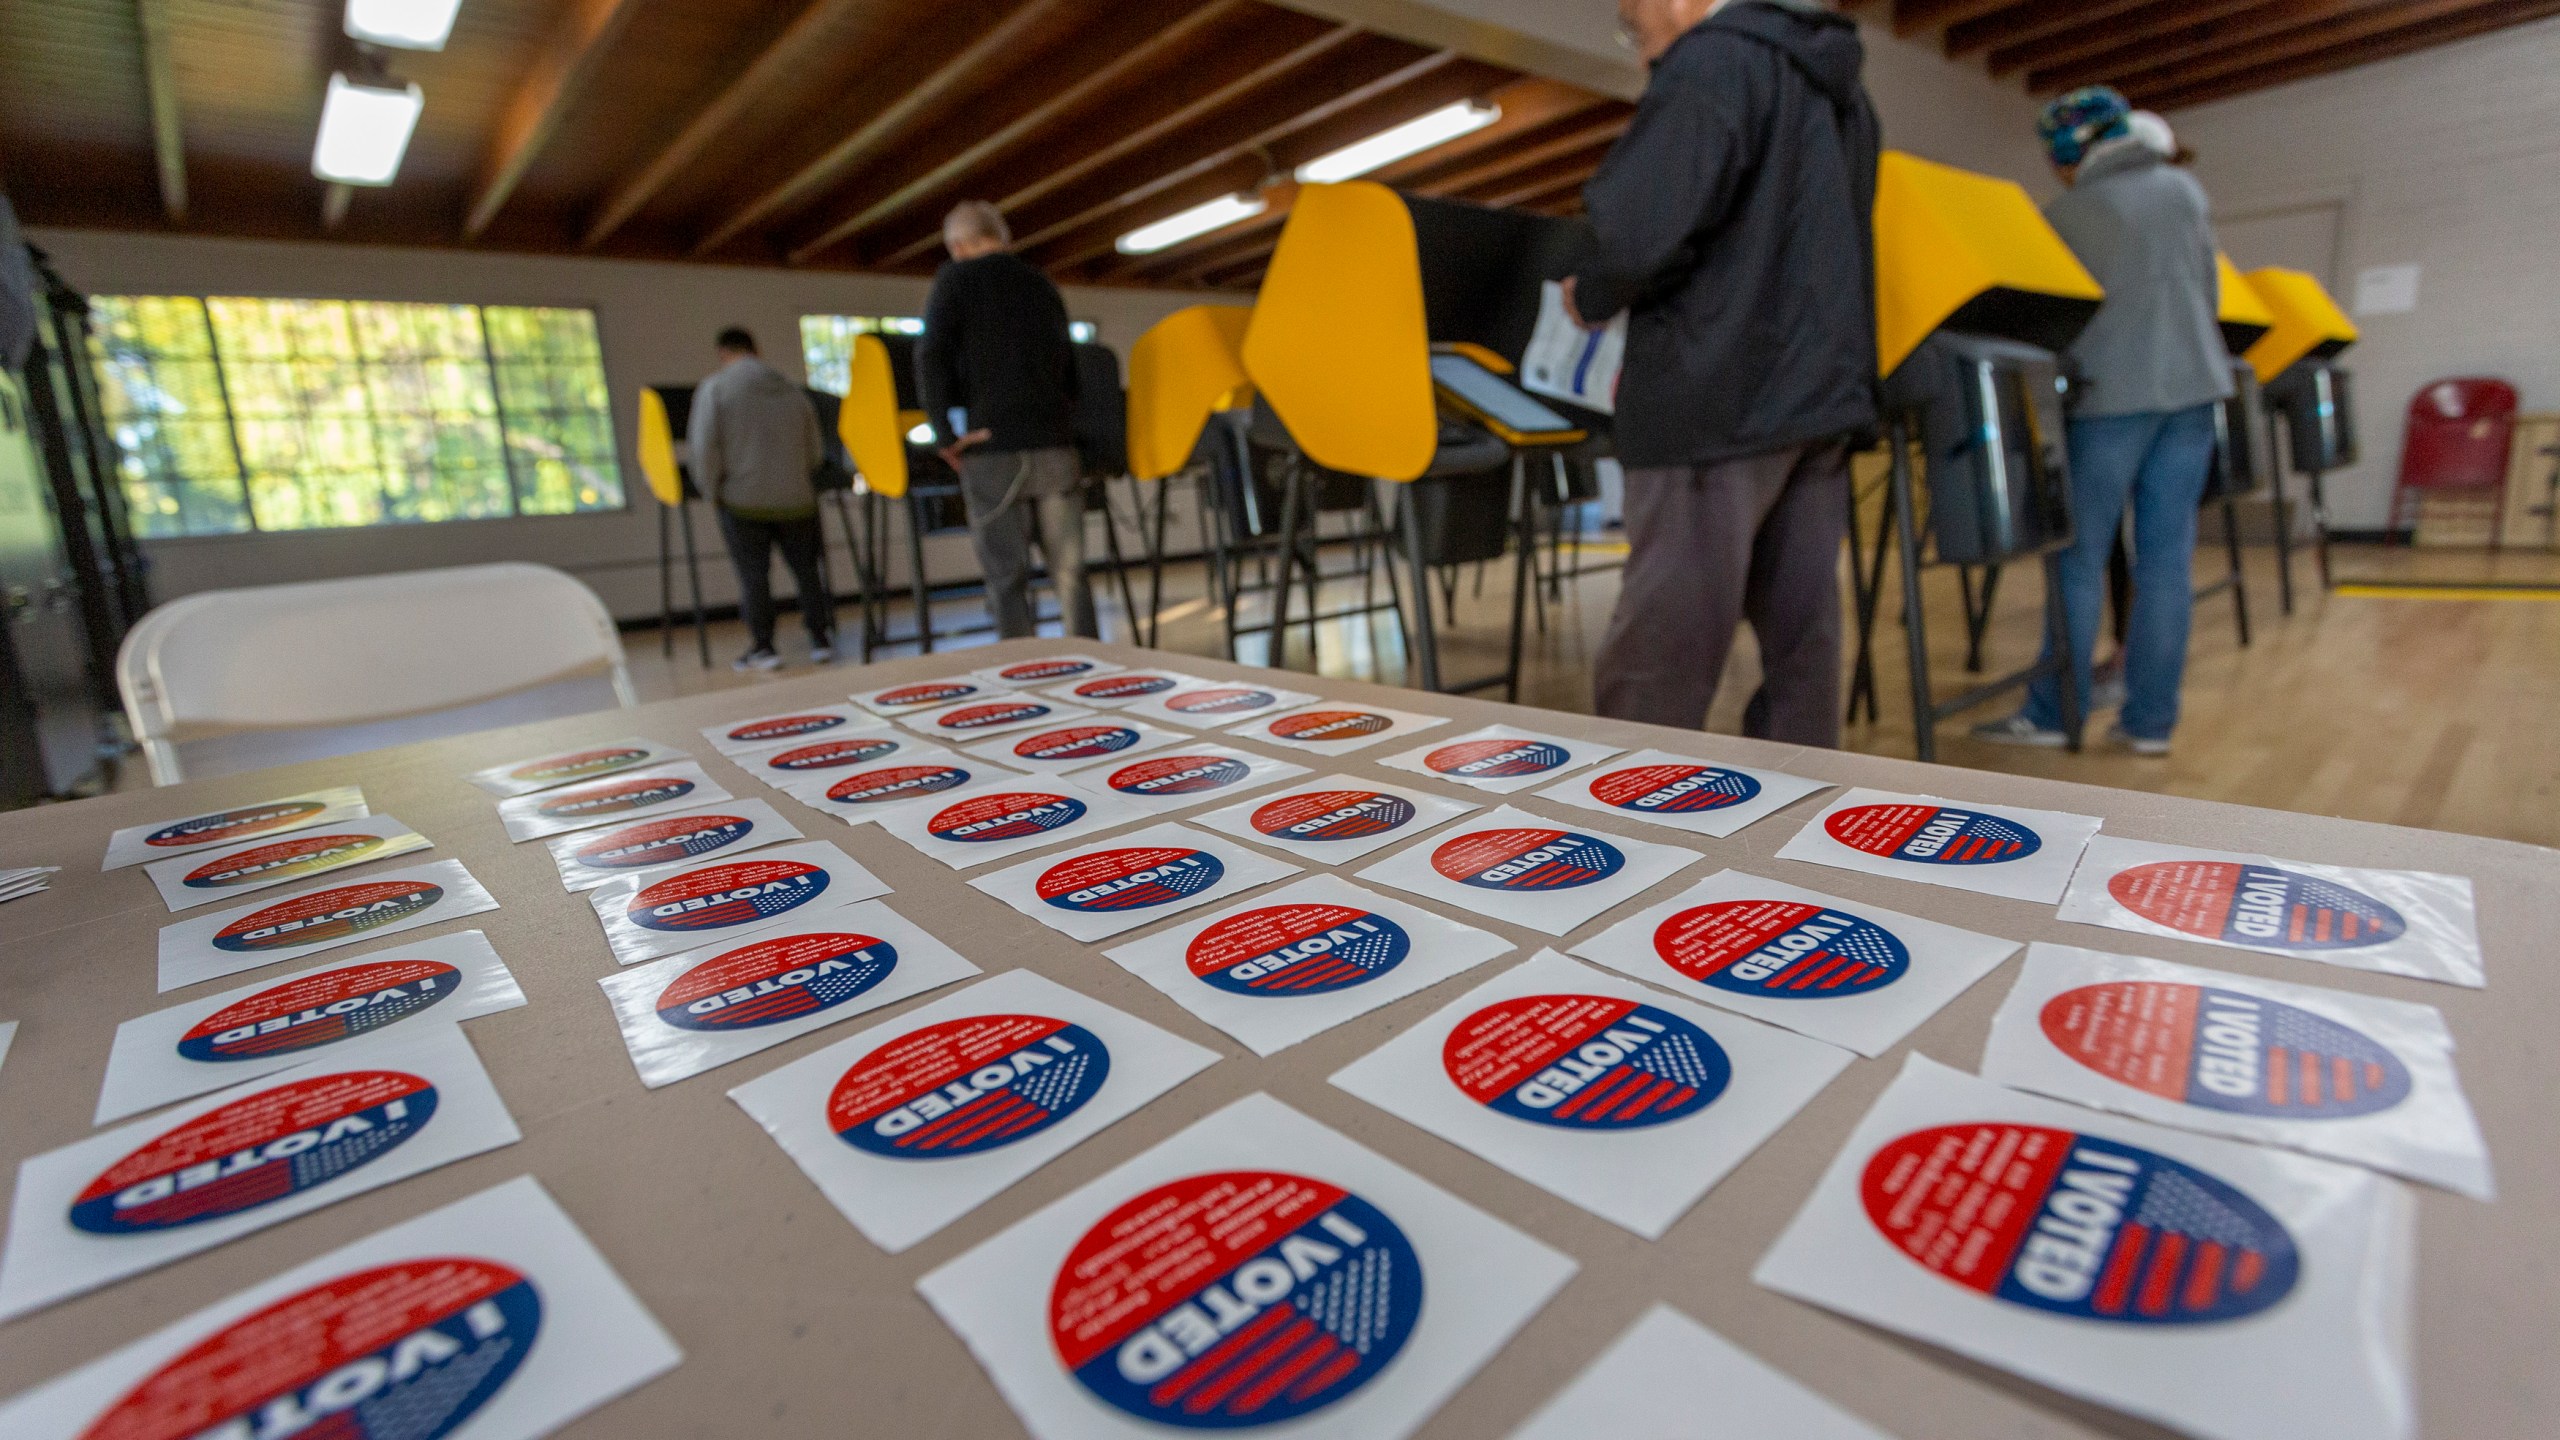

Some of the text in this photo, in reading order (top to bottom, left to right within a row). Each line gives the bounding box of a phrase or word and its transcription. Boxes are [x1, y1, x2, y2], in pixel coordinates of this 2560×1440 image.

[1295, 718, 1363, 738] VOTED
[1034, 734, 1113, 757] VOTED
[1457, 749, 1536, 773] VOTED
[847, 776, 940, 800] VOTED
[1136, 765, 1224, 790] VOTED
[1635, 776, 1713, 807] VOTED
[951, 806, 1051, 835] VOTED
[1050, 801, 1069, 810] I
[1290, 803, 1382, 833] VOTED
[598, 829, 719, 859] VOTED
[1904, 820, 1965, 856] VOTED
[209, 848, 347, 881] VOTED
[1180, 857, 1201, 867] I
[1480, 845, 1571, 882] VOTED
[795, 875, 811, 885] I
[1067, 865, 1187, 903] VOTED
[409, 893, 423, 901] I
[652, 881, 791, 917] VOTED
[2234, 872, 2289, 937] I VOTED
[242, 900, 400, 941] VOTED
[1352, 921, 1379, 932] I
[1818, 914, 1854, 926] I
[854, 951, 874, 962] I
[1230, 929, 1363, 981] VOTED
[1730, 925, 1843, 981] VOTED
[419, 978, 437, 992] I
[688, 960, 852, 1014] VOTED
[212, 988, 409, 1045] VOTED
[1625, 1016, 1666, 1034] I
[1044, 1036, 1076, 1054] I
[2198, 995, 2261, 1098] I VOTED
[1516, 1029, 1652, 1109] VOTED
[874, 1050, 1053, 1137] VOTED
[384, 1099, 408, 1121] I
[113, 1115, 374, 1209] VOTED
[2073, 1147, 2141, 1176] I
[1319, 1211, 1368, 1247] I
[2013, 1169, 2136, 1302] VOTED
[465, 1301, 506, 1339] I
[1116, 1234, 1344, 1385] VOTED
